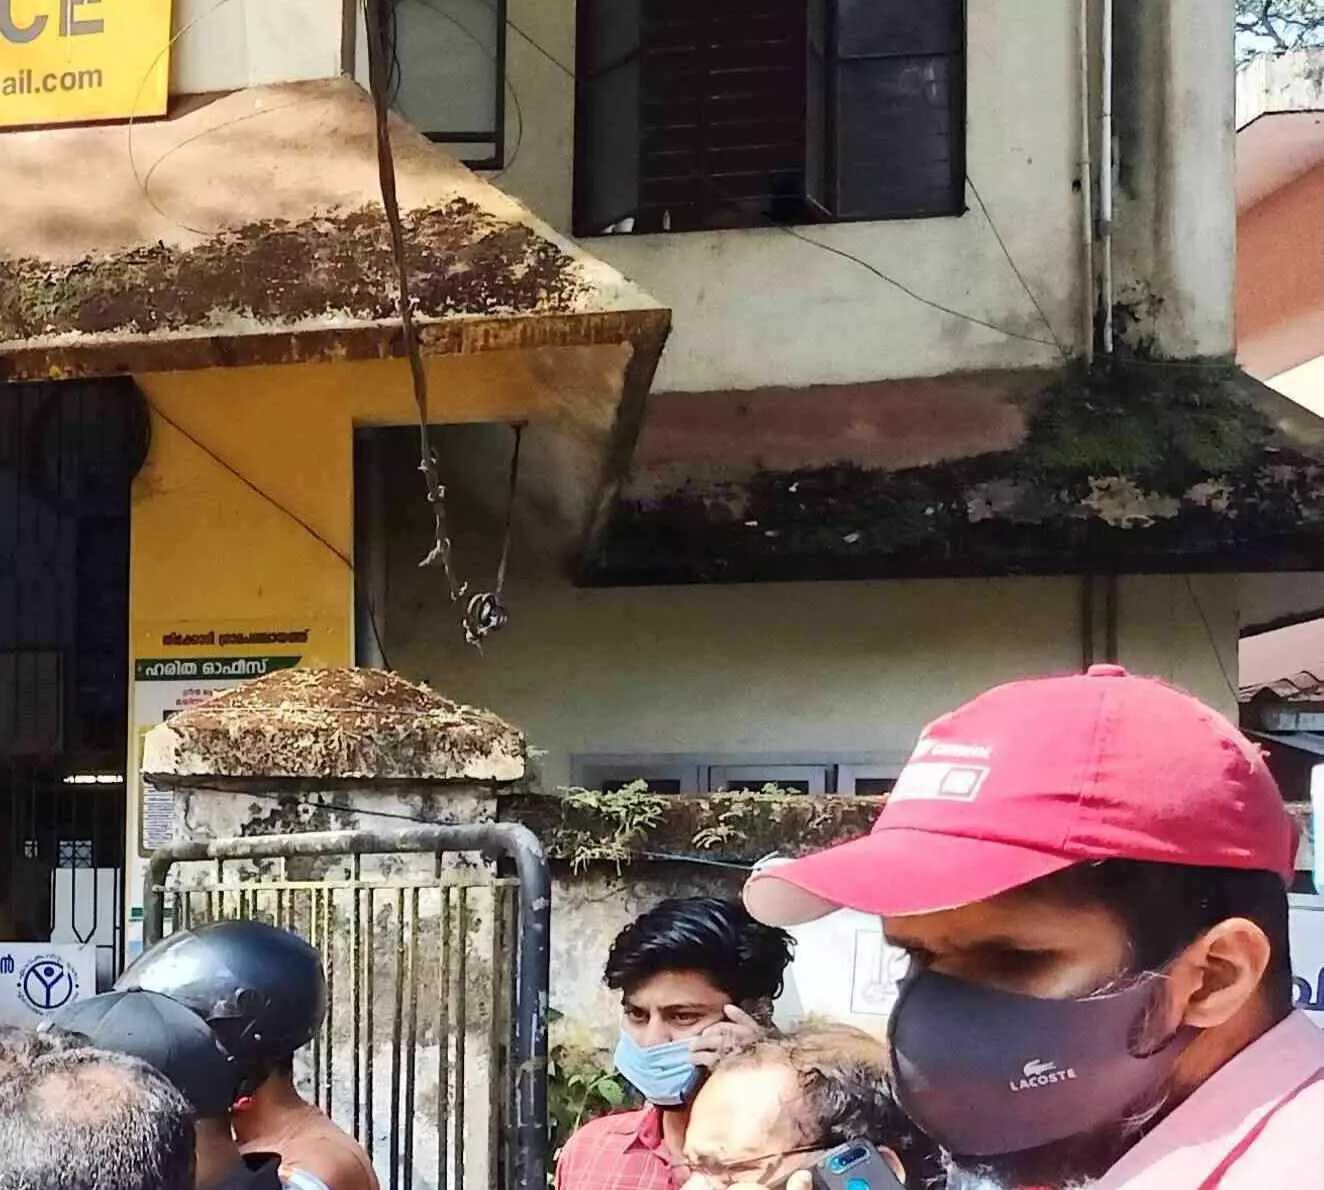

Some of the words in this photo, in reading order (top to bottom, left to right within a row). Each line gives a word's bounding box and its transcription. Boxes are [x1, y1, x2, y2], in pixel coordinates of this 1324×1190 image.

[145, 659, 197, 677] ഹരിത
[202, 658, 270, 676] ഓഫീസ്
[1008, 1067, 1077, 1092] LACOSTE
